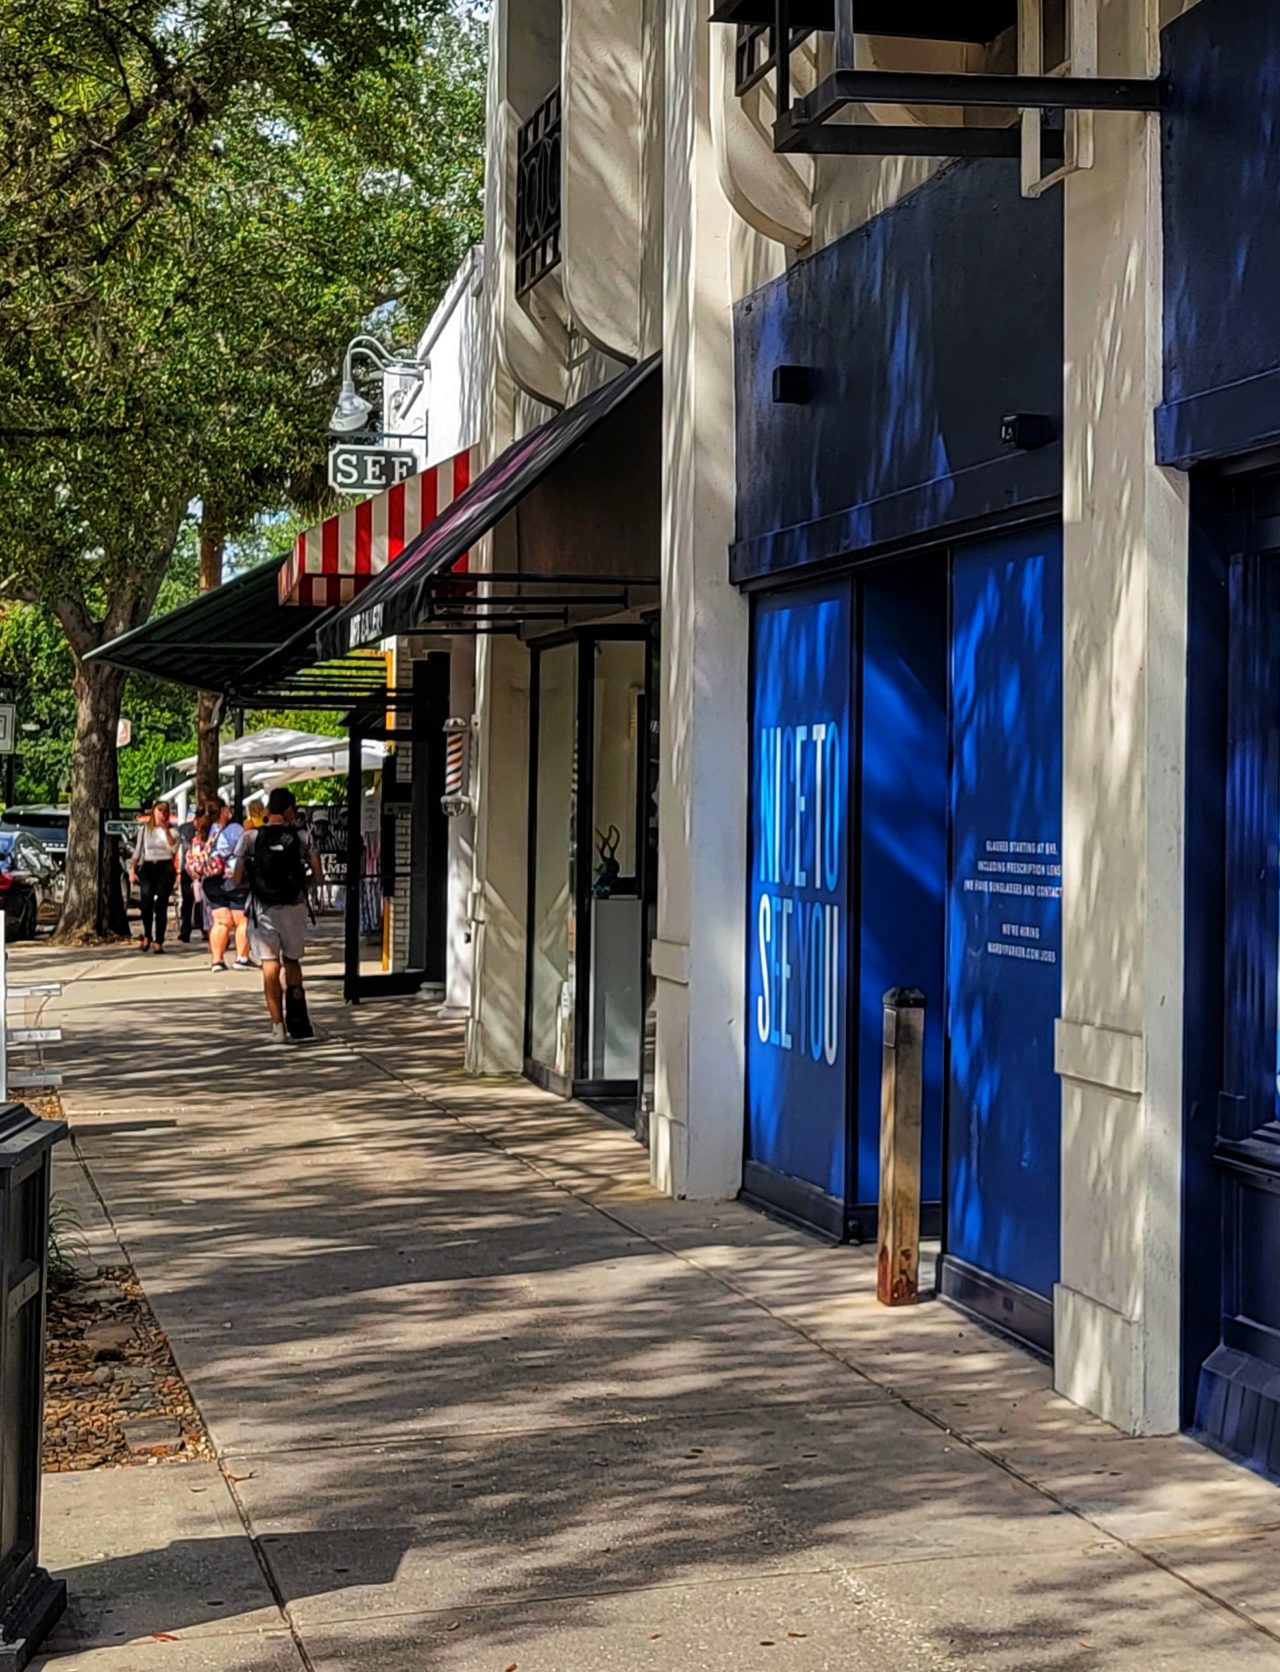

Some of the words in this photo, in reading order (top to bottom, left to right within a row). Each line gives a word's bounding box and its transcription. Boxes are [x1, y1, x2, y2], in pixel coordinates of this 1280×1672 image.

[759, 725, 807, 887] NICE
[813, 721, 840, 892] TO
[758, 893, 792, 1049] SEE
[797, 901, 839, 1065] YOU
